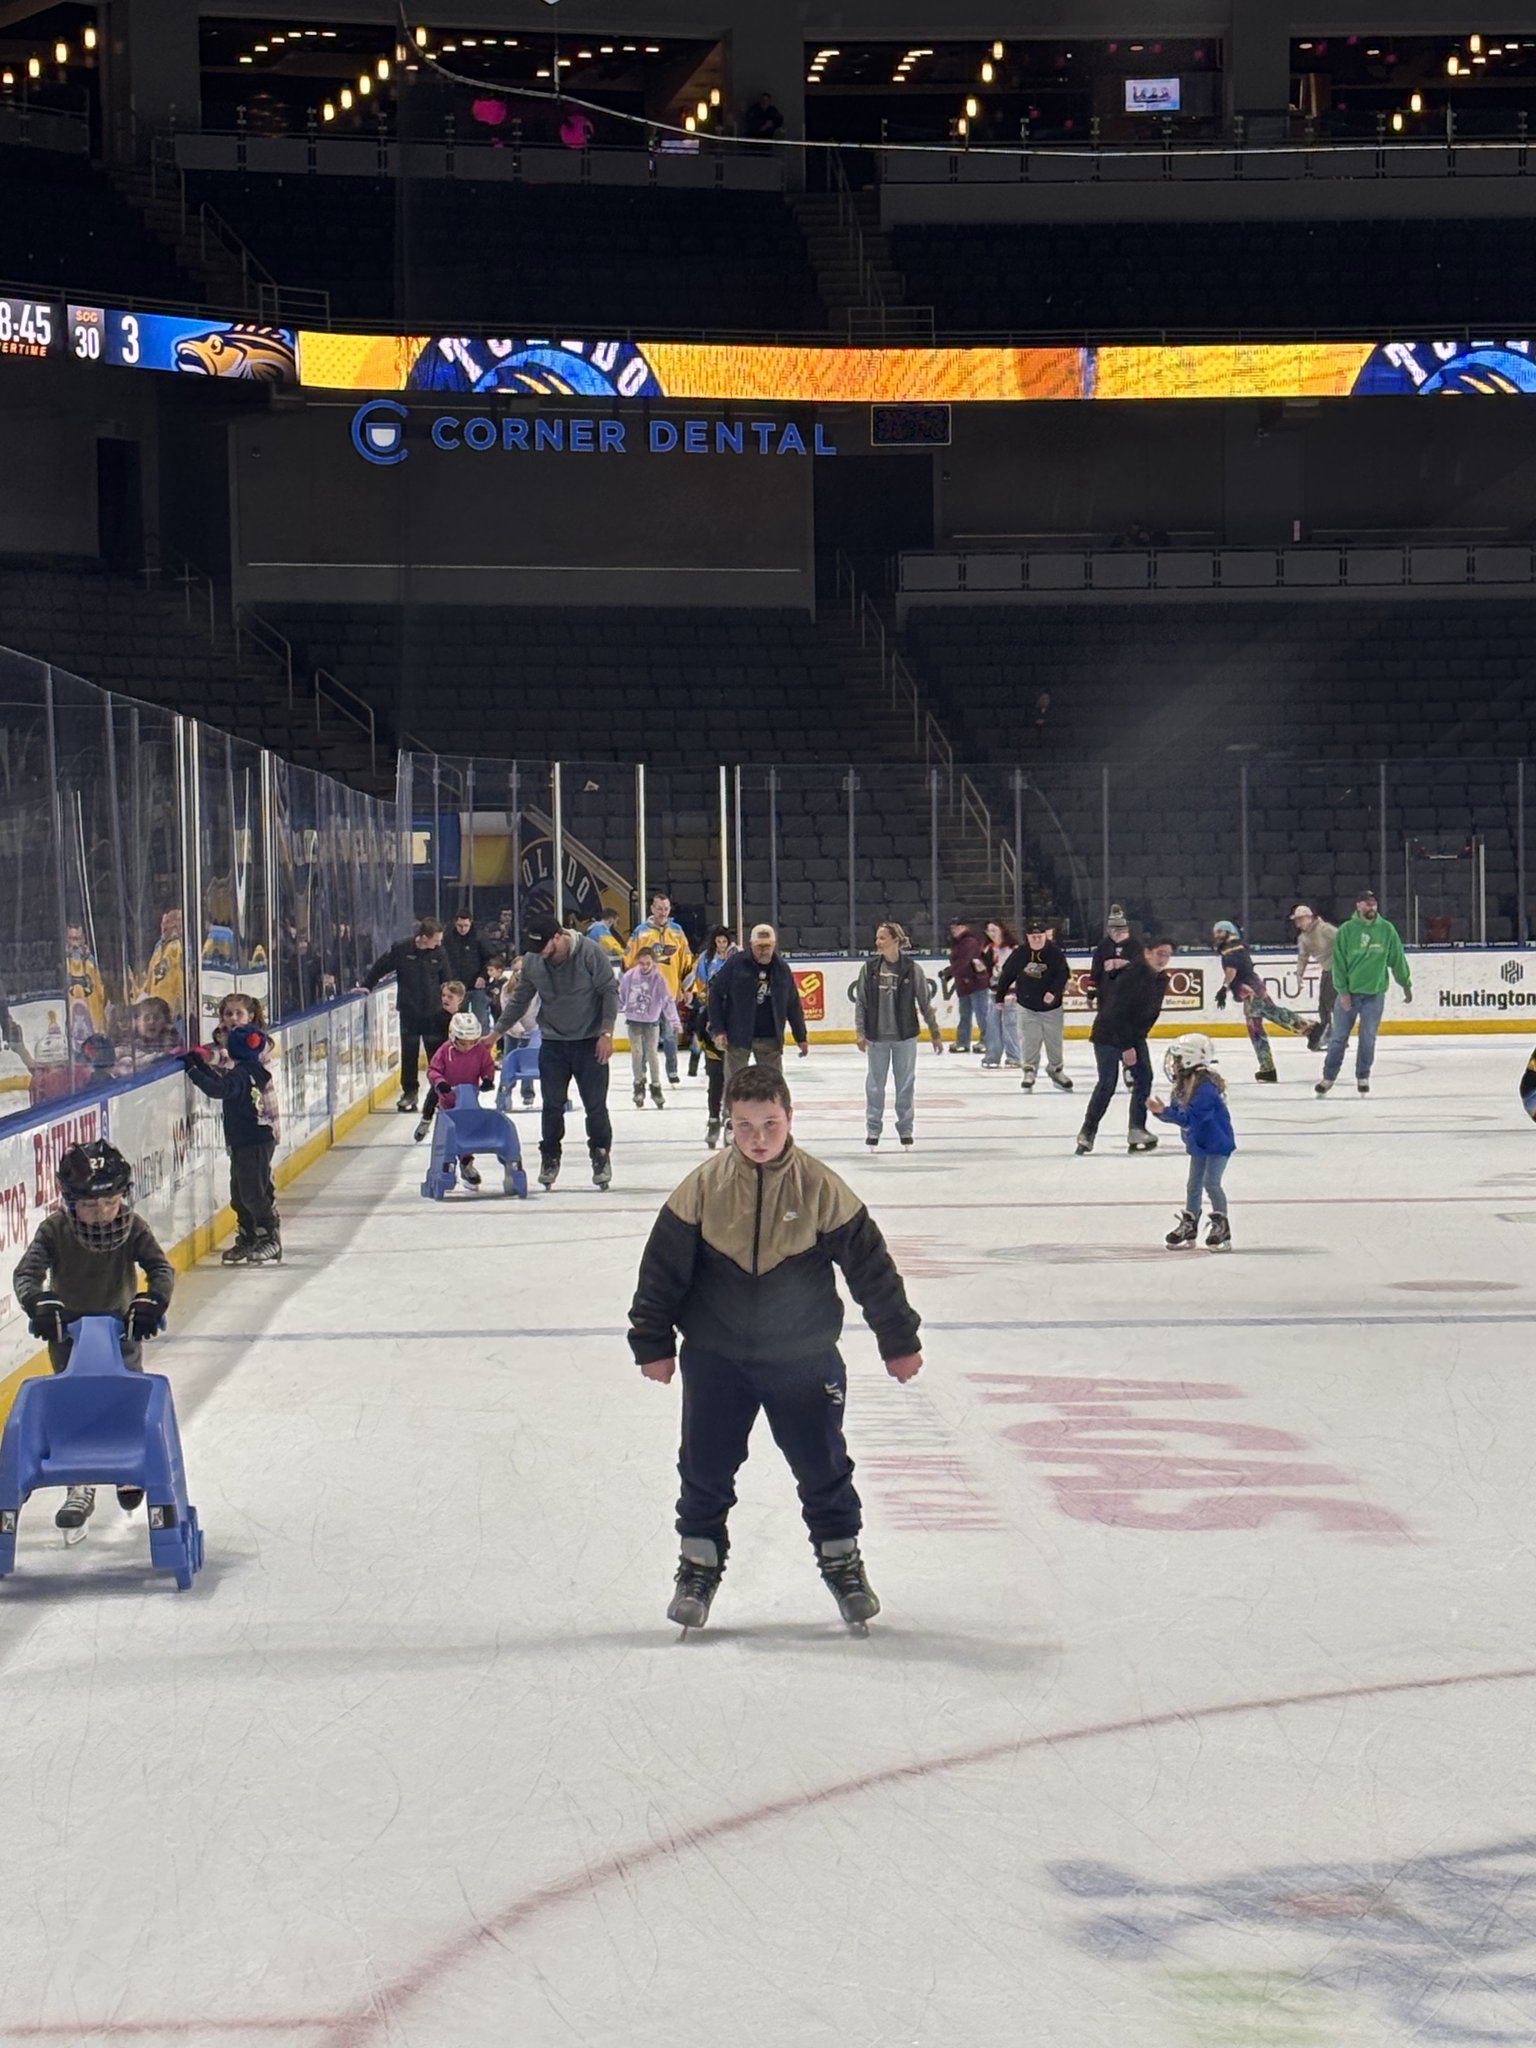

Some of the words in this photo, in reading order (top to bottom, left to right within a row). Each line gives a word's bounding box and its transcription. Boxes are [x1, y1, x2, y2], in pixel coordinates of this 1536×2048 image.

[75, 310, 98, 323] SOG
[0, 342, 48, 357] ERTIME
[75, 326, 100, 359] 30
[121, 315, 140, 363] 3
[432, 416, 627, 455] CORNER
[650, 420, 838, 456] DENTAL
[1438, 989, 1536, 1010] Huntington
[89, 1157, 105, 1170] 27
